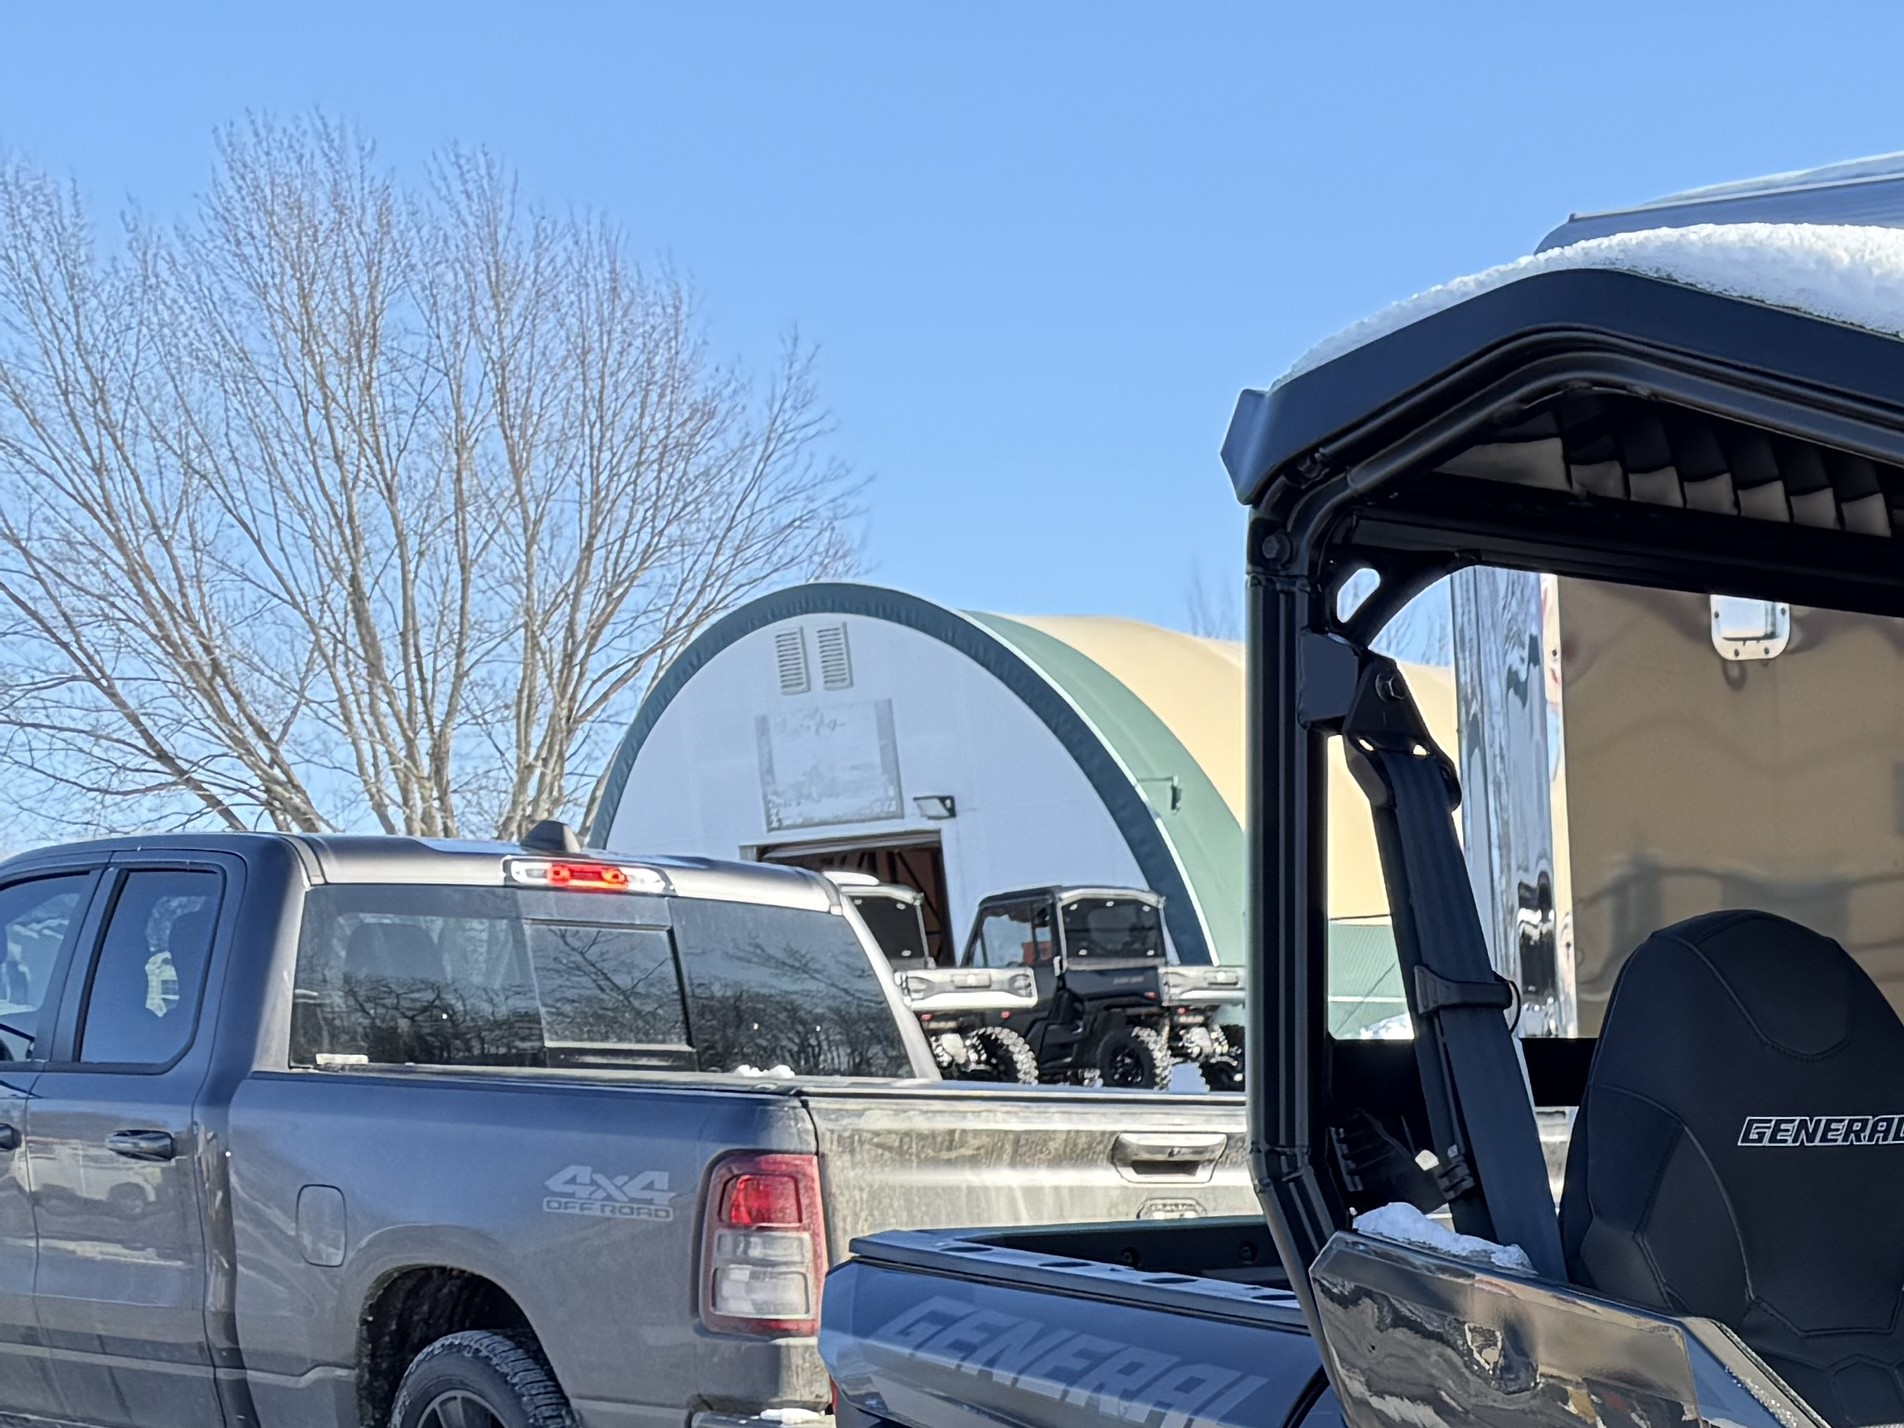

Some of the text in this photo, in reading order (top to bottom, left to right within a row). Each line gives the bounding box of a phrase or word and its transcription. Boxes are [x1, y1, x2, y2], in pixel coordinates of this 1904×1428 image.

[544, 1165, 678, 1205] 4x4
[546, 1199, 672, 1219] OFF ROAD
